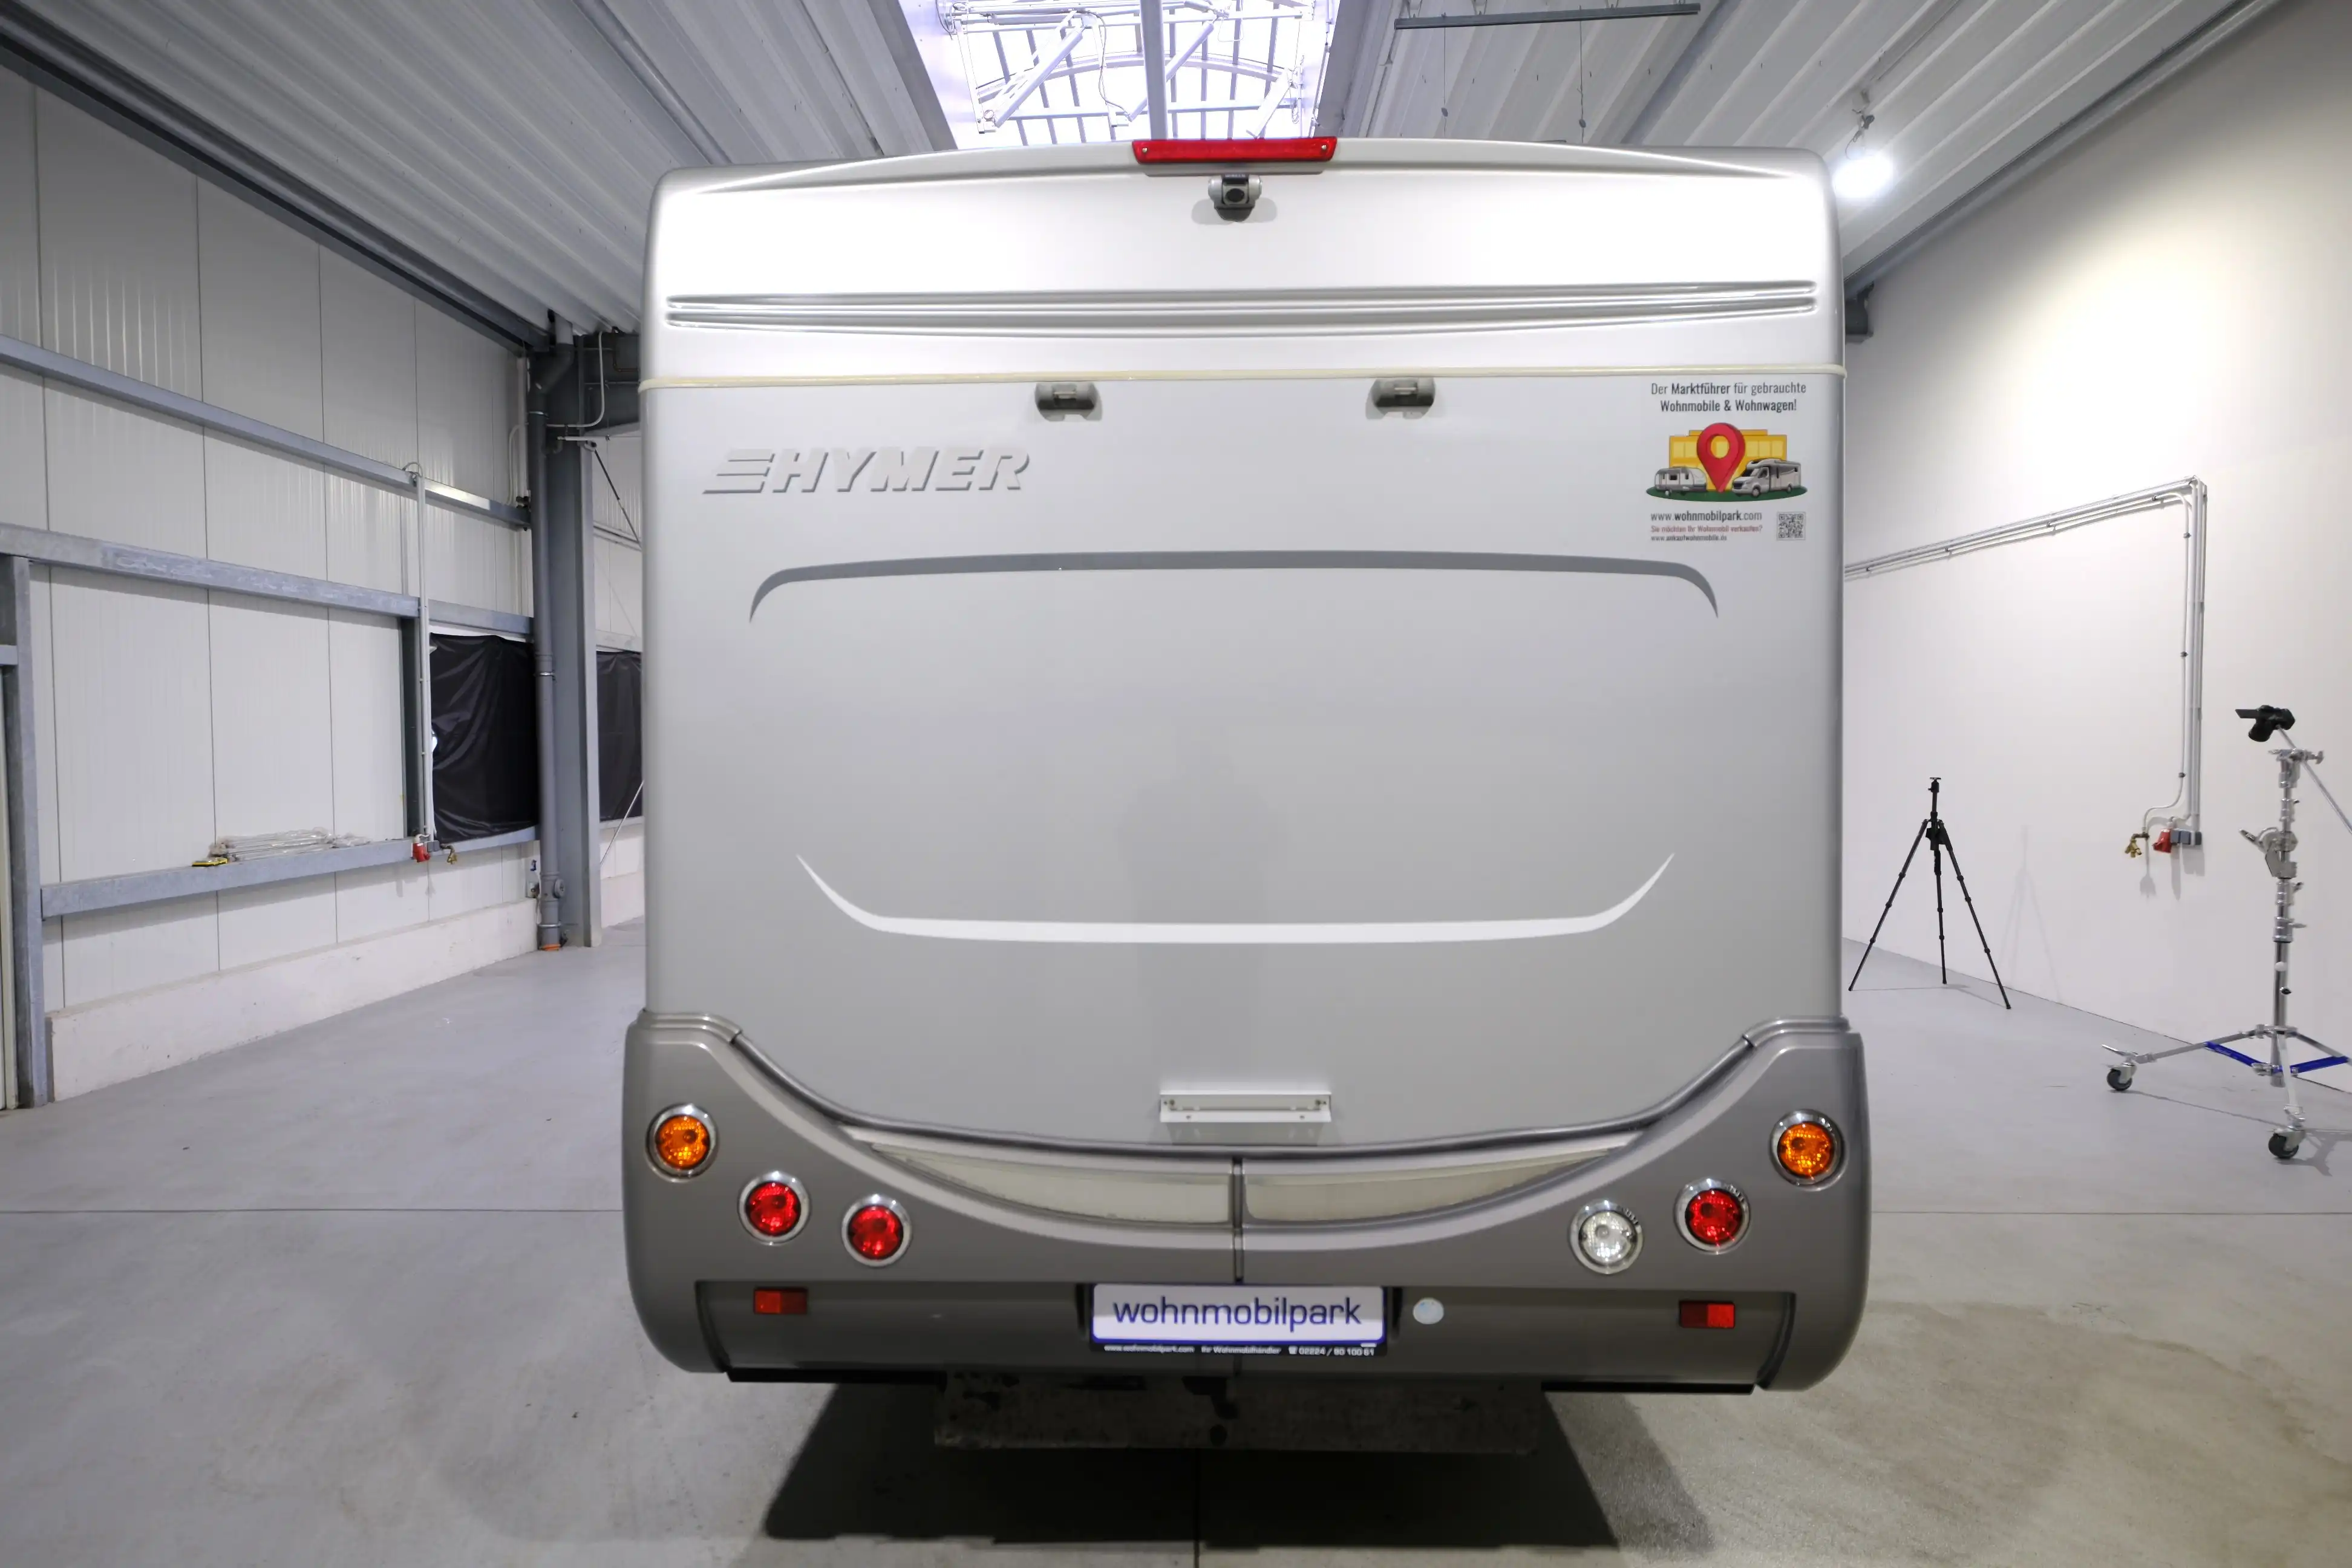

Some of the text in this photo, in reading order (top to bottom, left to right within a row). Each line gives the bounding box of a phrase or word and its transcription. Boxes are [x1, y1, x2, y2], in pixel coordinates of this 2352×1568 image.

[1651, 382, 1806, 396] Der Marktführer für gebrauchte
[1661, 399, 1797, 413] Wohnmobile & Wohnwagen!
[1651, 510, 1762, 523] www.wohnmobilpark.com
[1113, 1296, 1362, 1332] wohnmobilpark
